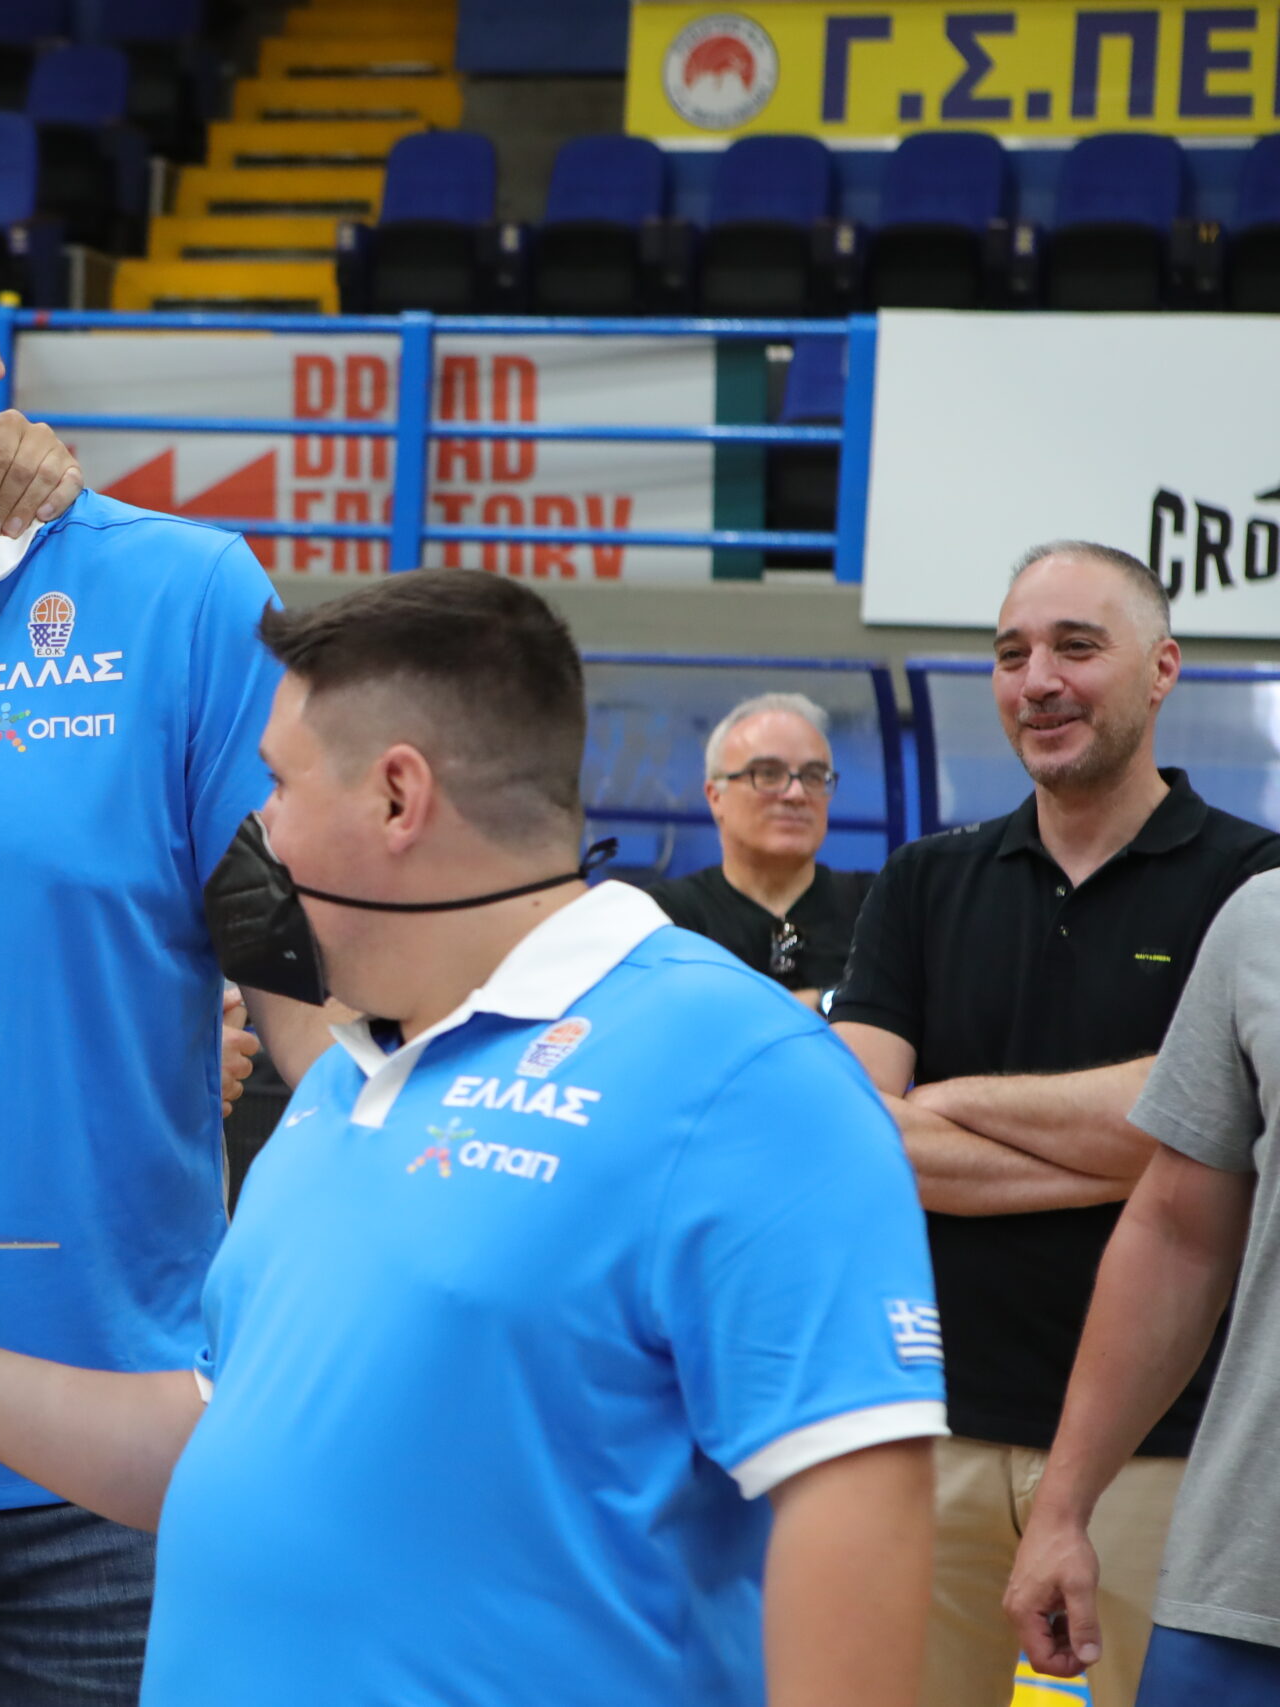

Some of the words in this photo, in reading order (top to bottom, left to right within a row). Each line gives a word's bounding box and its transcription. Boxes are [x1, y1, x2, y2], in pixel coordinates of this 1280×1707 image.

[821, 7, 1280, 123] Γ.Σ.ΠΕ
[292, 354, 538, 484] BRAD
[291, 489, 634, 580] FATORY
[441, 1075, 601, 1127] ΕΛΛΑΣ
